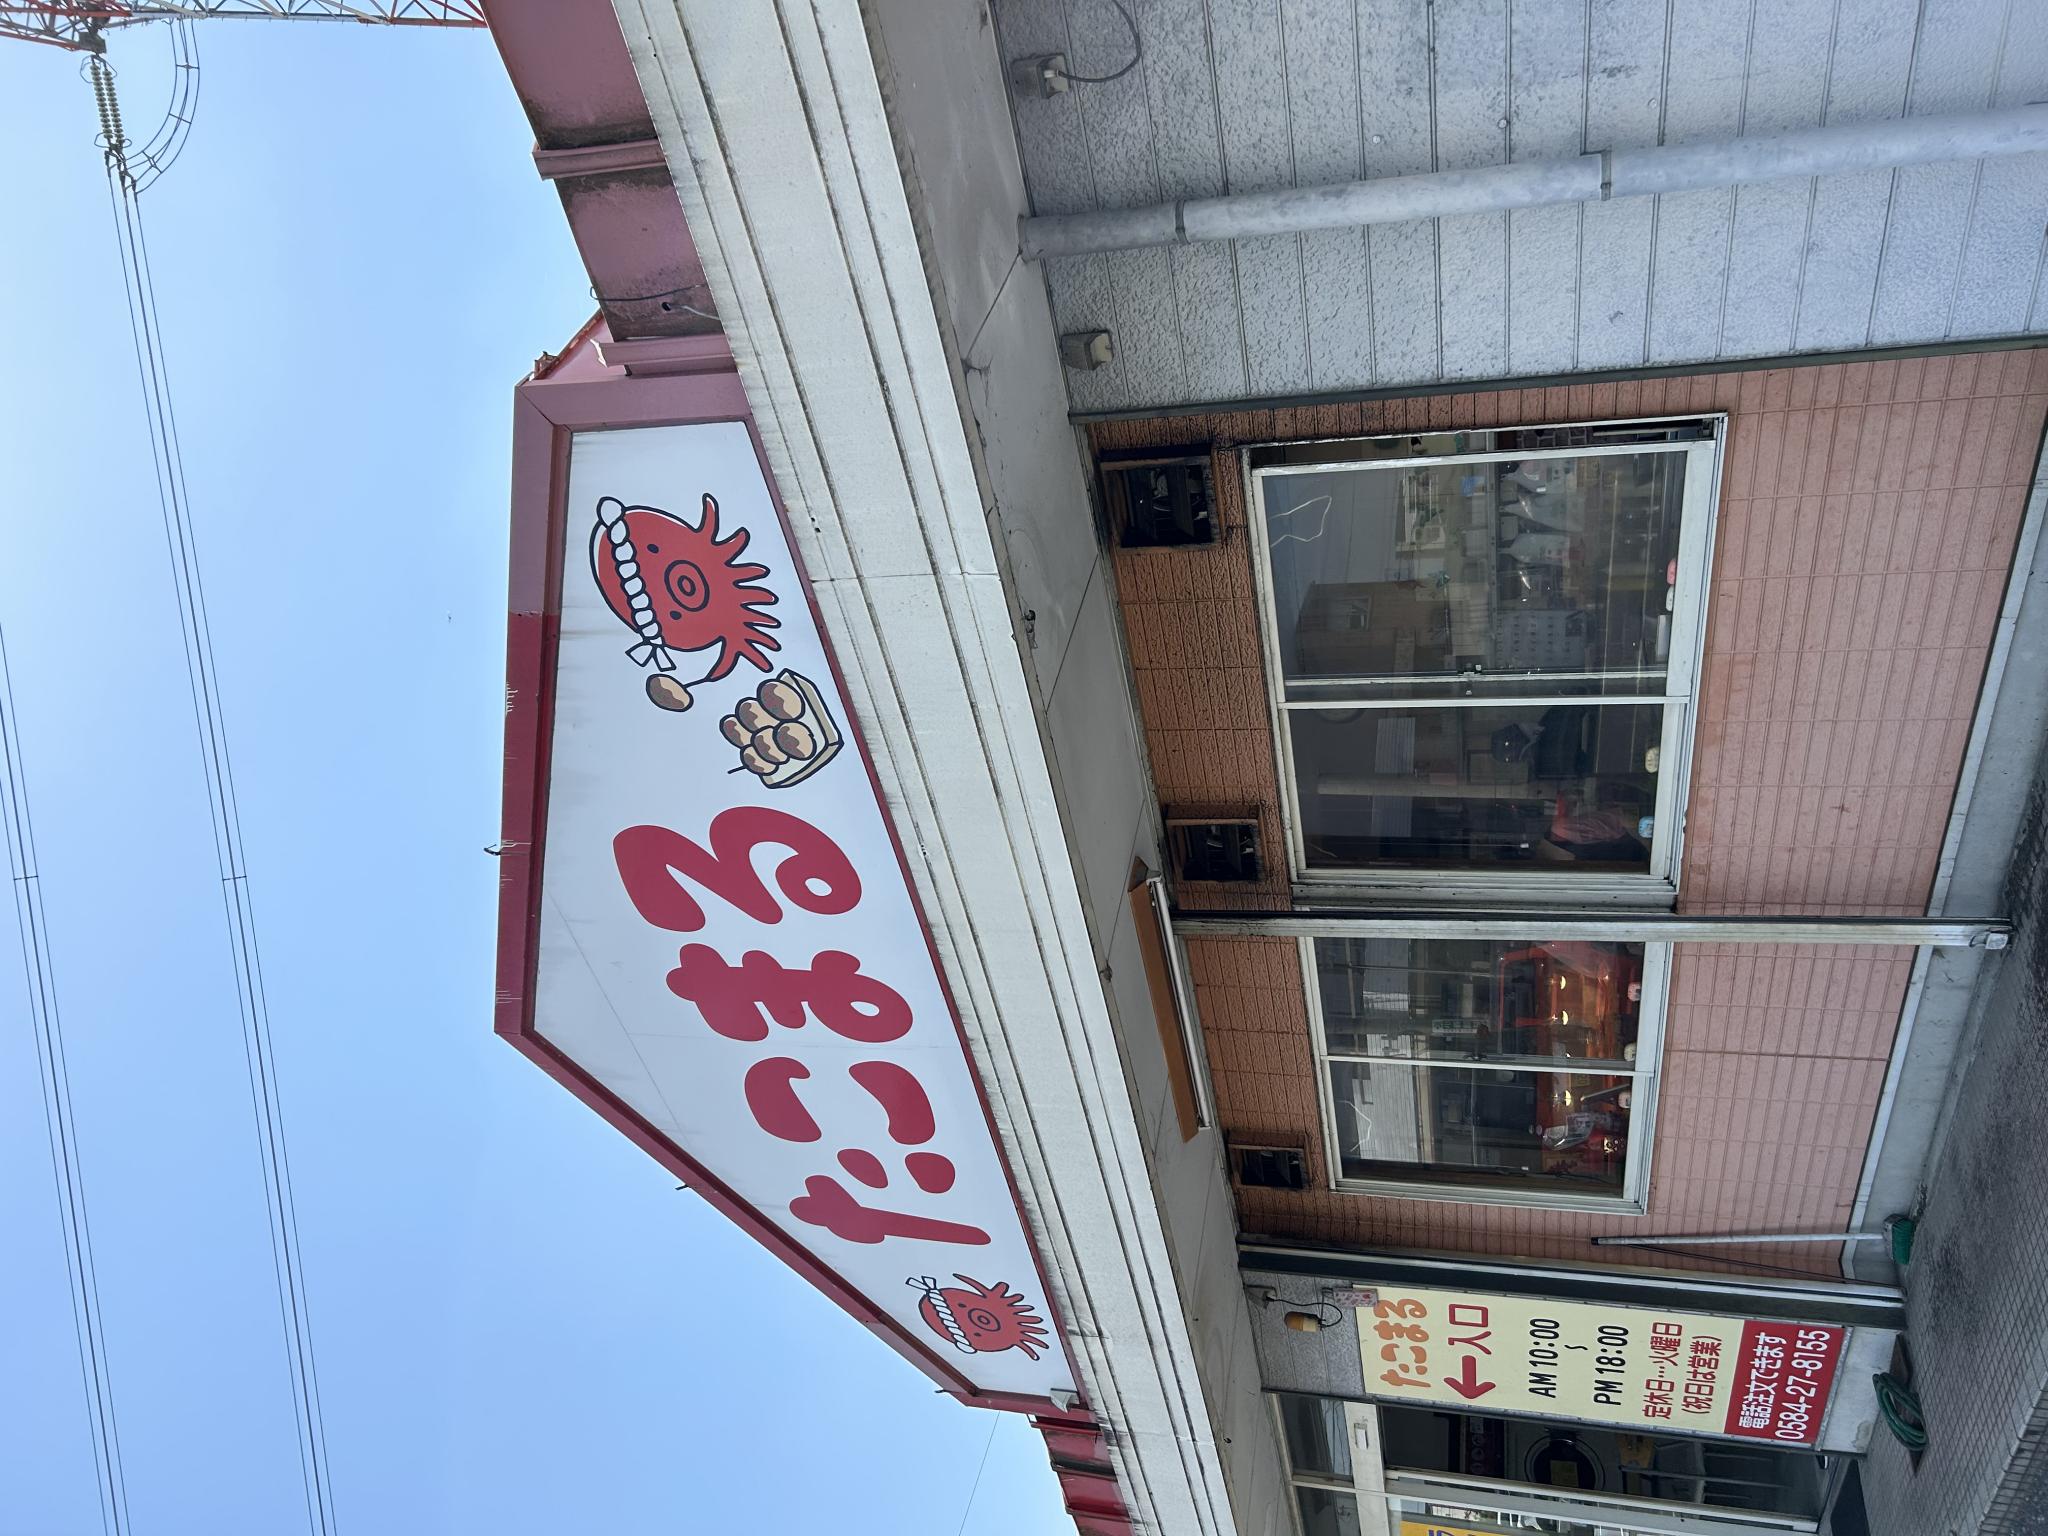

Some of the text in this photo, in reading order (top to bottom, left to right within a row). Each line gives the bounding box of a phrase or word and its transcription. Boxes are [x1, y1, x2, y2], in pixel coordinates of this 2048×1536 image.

[613, 806, 991, 1246] たこまる
[1373, 1299, 1430, 1388] たこまる
[1448, 1303, 1492, 1355] 入口
[1528, 1318, 1560, 1399] AM 10:00
[1593, 1325, 1629, 1406] PM 18:00
[1738, 1331, 1787, 1429] 電話注文できます
[1774, 1329, 1831, 1440] 0584-27-8155
